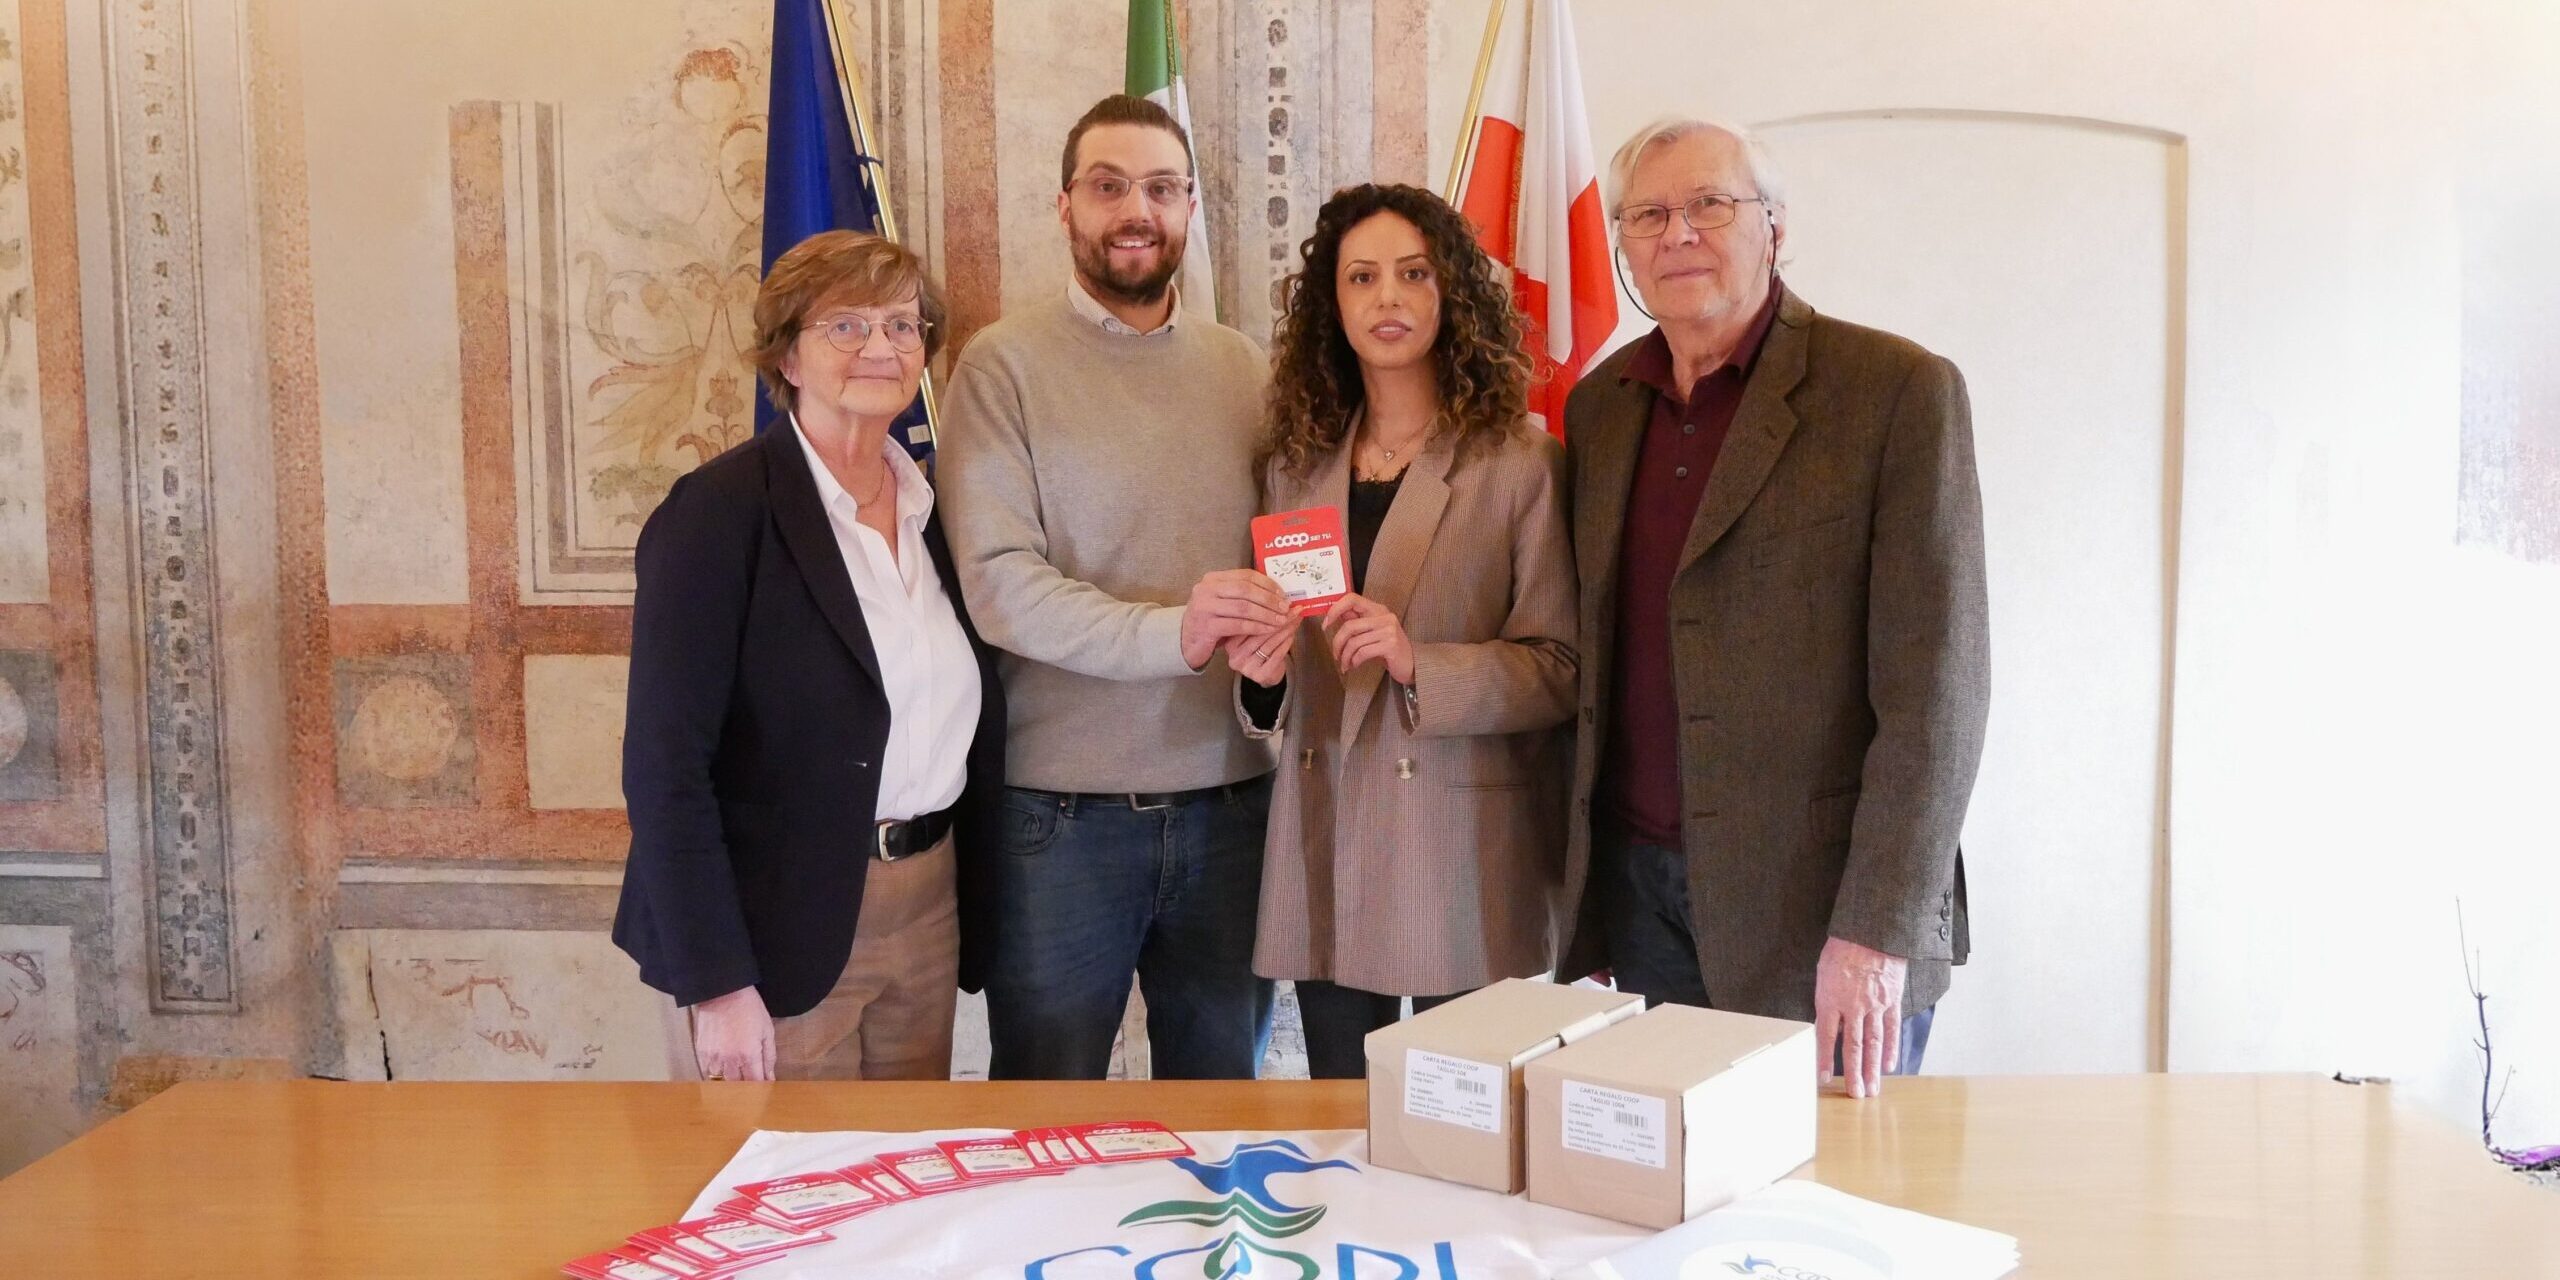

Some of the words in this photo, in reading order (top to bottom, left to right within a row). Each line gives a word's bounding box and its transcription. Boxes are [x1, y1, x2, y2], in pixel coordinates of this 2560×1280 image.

[1422, 1055, 1440, 1064] CARTA
[1440, 1058, 1462, 1068] REGALO
[1463, 1063, 1480, 1072] COOP
[1436, 1065, 1456, 1074] TAGLIO
[1579, 1086, 1598, 1096] CARTA
[1600, 1090, 1622, 1100] REGALO
[1624, 1095, 1640, 1104] COOP
[1590, 1096, 1610, 1106] TAGLIO
